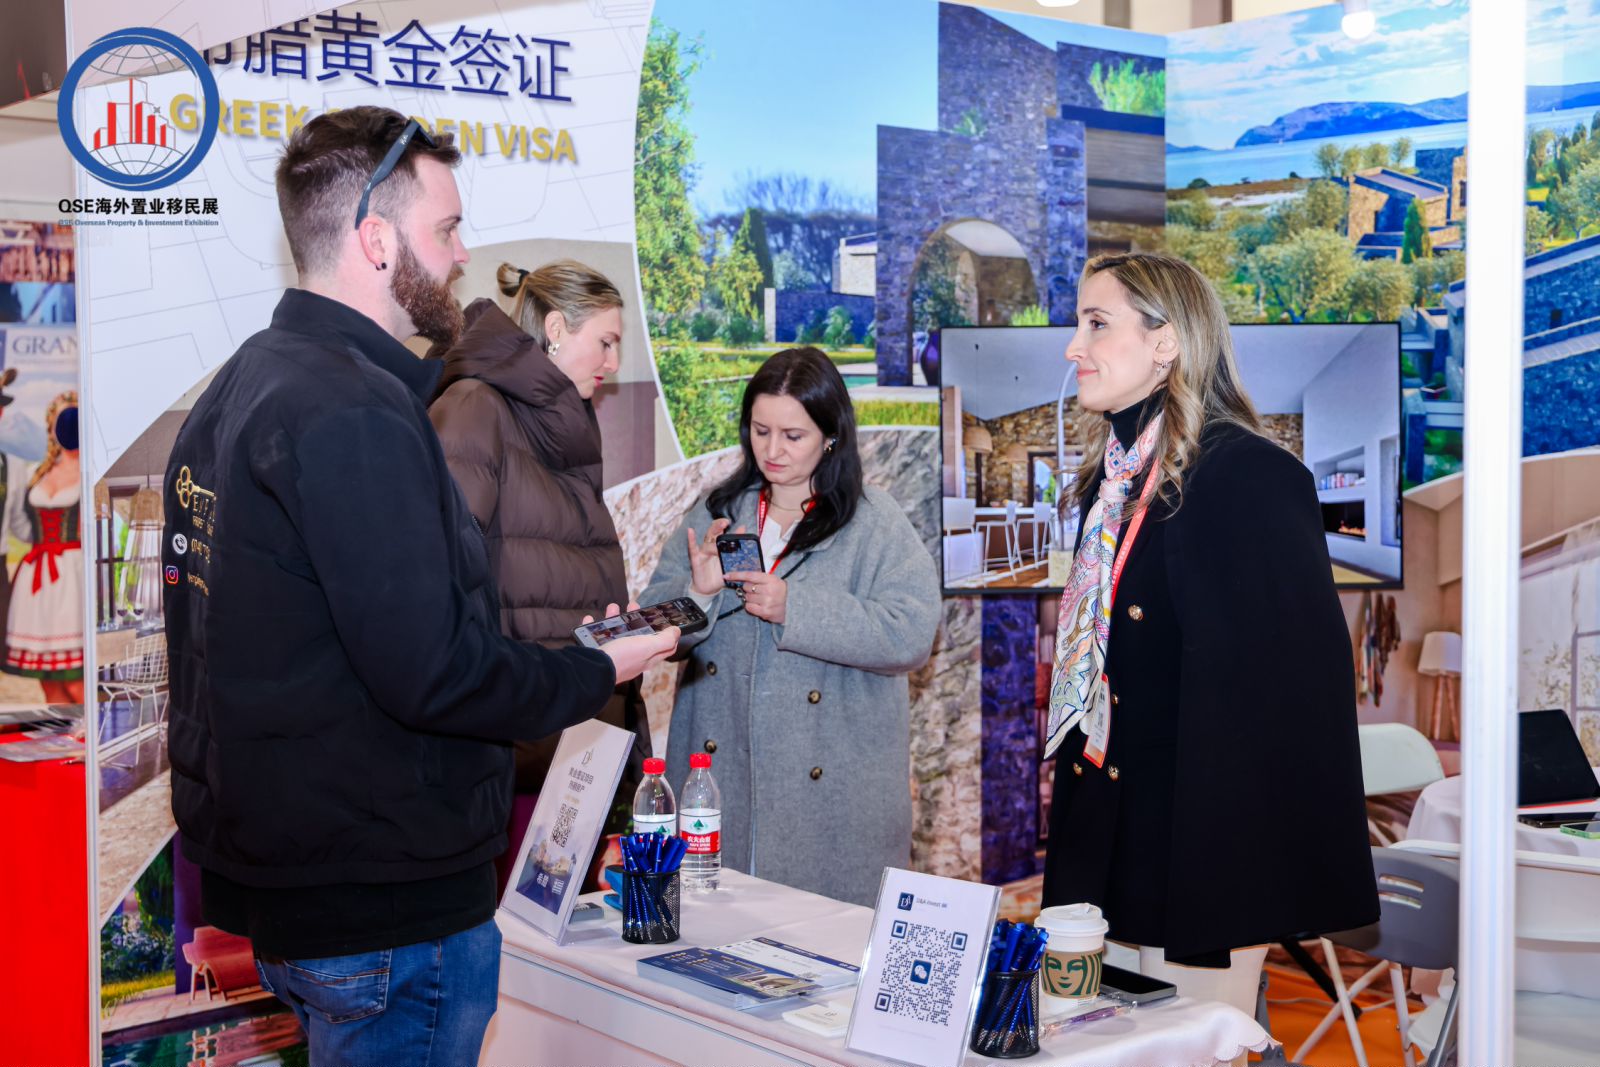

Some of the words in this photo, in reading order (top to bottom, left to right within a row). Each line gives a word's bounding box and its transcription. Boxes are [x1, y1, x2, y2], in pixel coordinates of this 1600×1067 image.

[203, 9, 572, 102] 腊黄金签证
[495, 121, 577, 162] VISA
